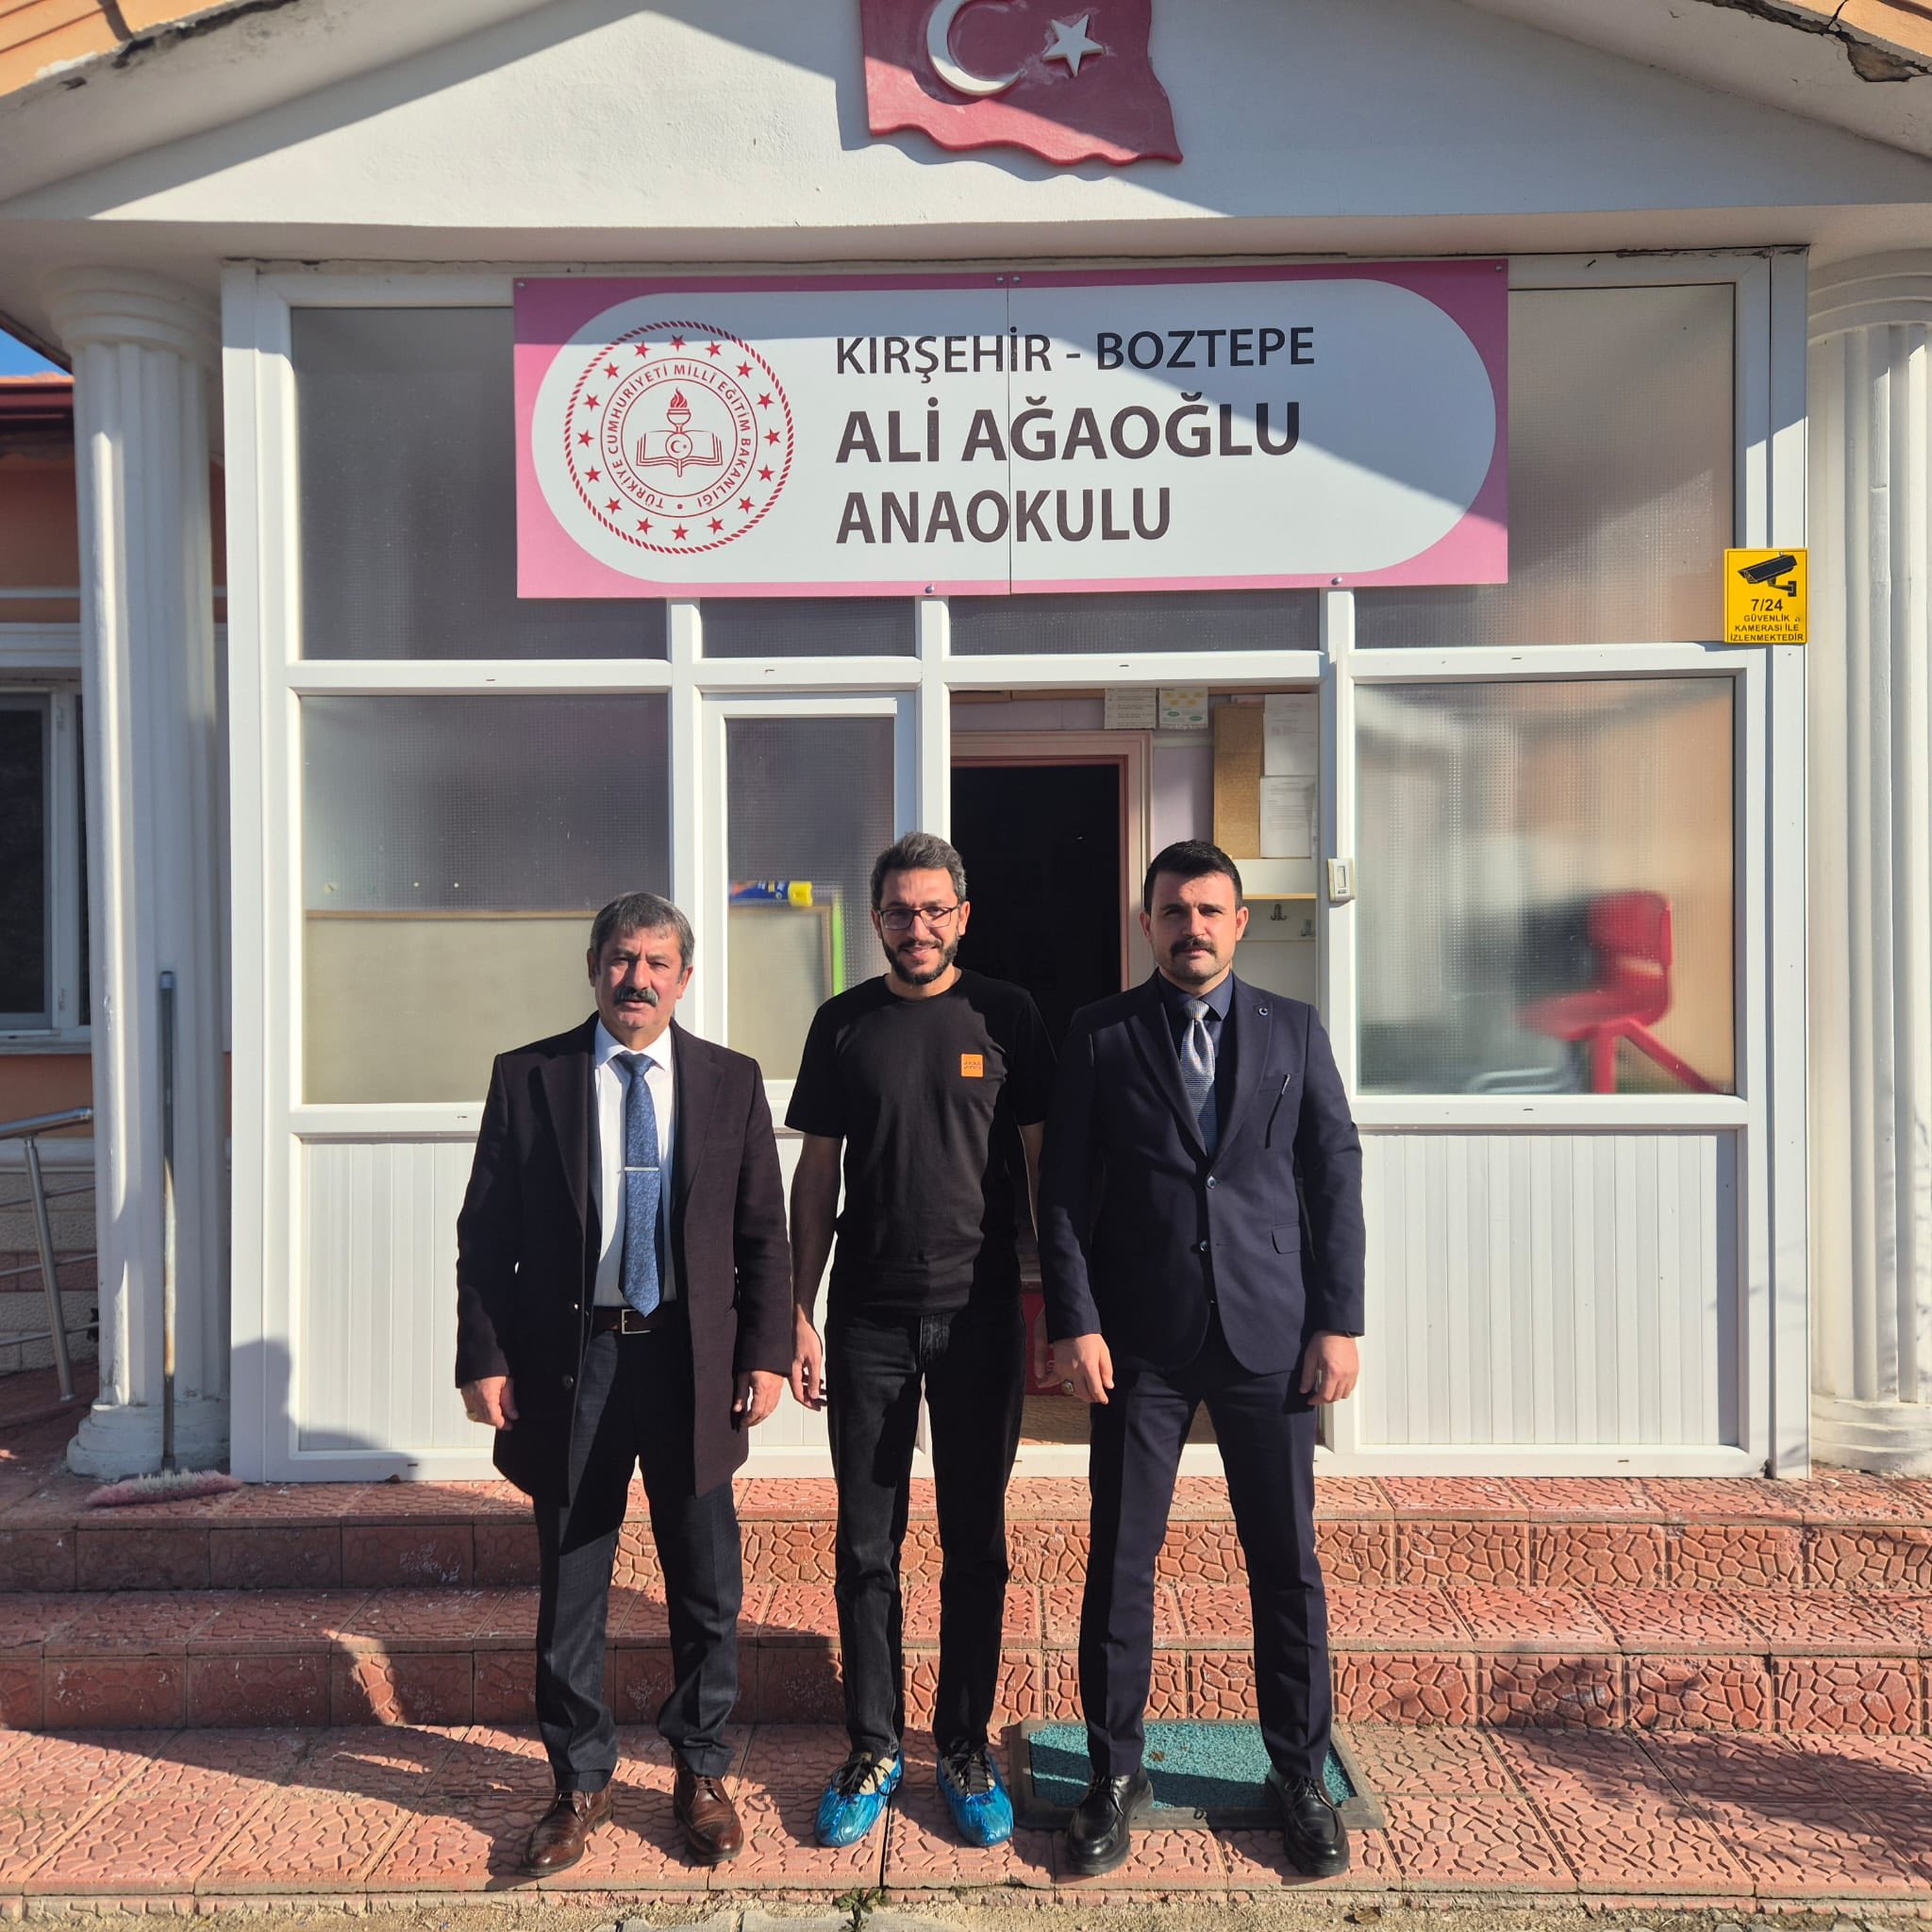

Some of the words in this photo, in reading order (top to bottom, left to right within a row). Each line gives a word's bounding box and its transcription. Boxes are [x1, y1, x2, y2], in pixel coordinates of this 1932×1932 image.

[837, 326, 1052, 384] KIRŞEHİR
[1097, 326, 1315, 370] BOZTEPE
[607, 363, 669, 455] CUMHURİYETİ
[717, 381, 752, 432] EĞİTİM
[836, 396, 940, 463] ALİ
[960, 391, 1300, 462] AĞAOĞLU
[612, 459, 664, 509] TÜRKİYE
[697, 438, 752, 508] BAKANLIĞI
[836, 487, 1170, 544] ANAOKULU
[1735, 624, 1783, 632] KAMERASI
[1785, 623, 1799, 632] İLE
[1743, 613, 1790, 623] GÜVENLİK
[1751, 598, 1783, 611] 7/24
[1730, 633, 1804, 641] İZLENMEKTEDİR
